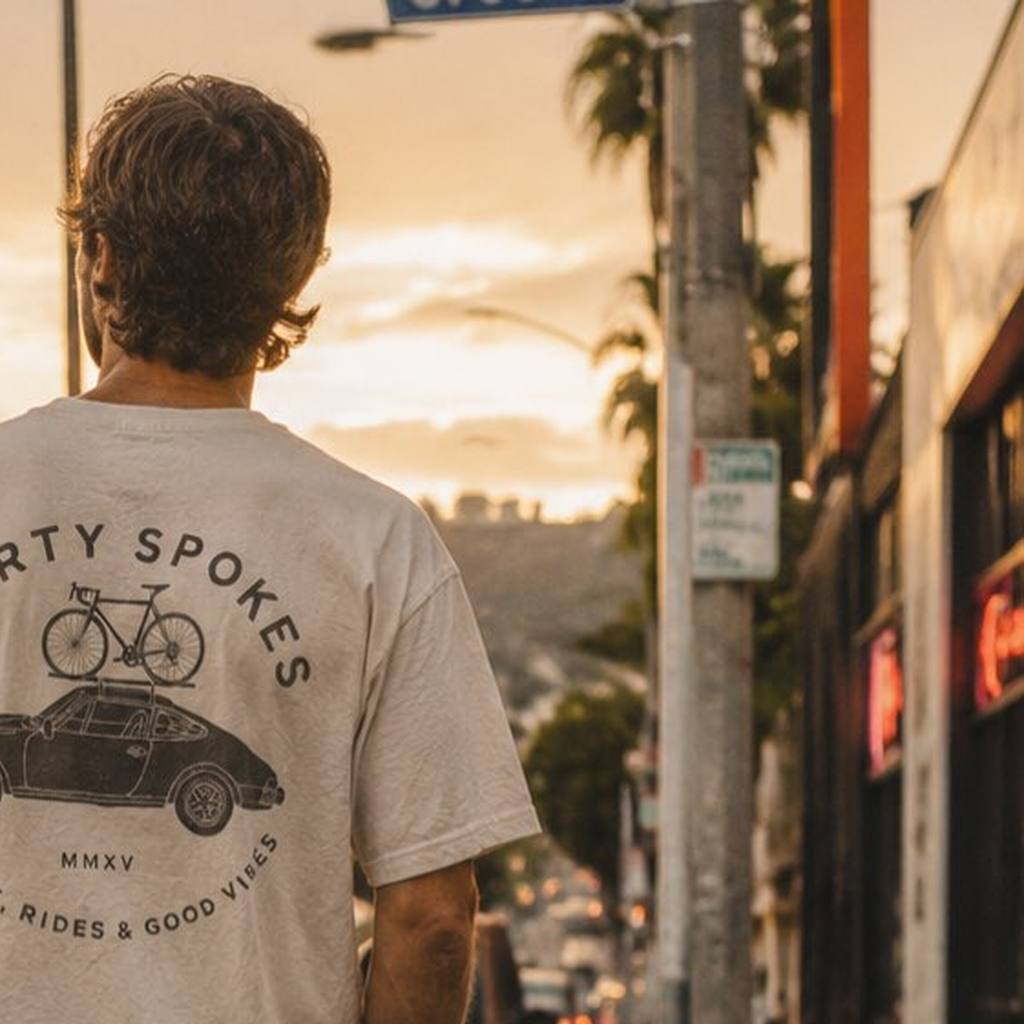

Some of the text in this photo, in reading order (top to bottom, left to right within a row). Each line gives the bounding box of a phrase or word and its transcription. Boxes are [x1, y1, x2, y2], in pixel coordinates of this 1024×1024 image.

[134, 527, 311, 689] SPOKES
[19, 903, 105, 940] RIDES
[117, 920, 133, 940] &
[144, 898, 215, 936] GOOD
[221, 833, 277, 900] VIBES
[61, 852, 135, 872] MMXV
